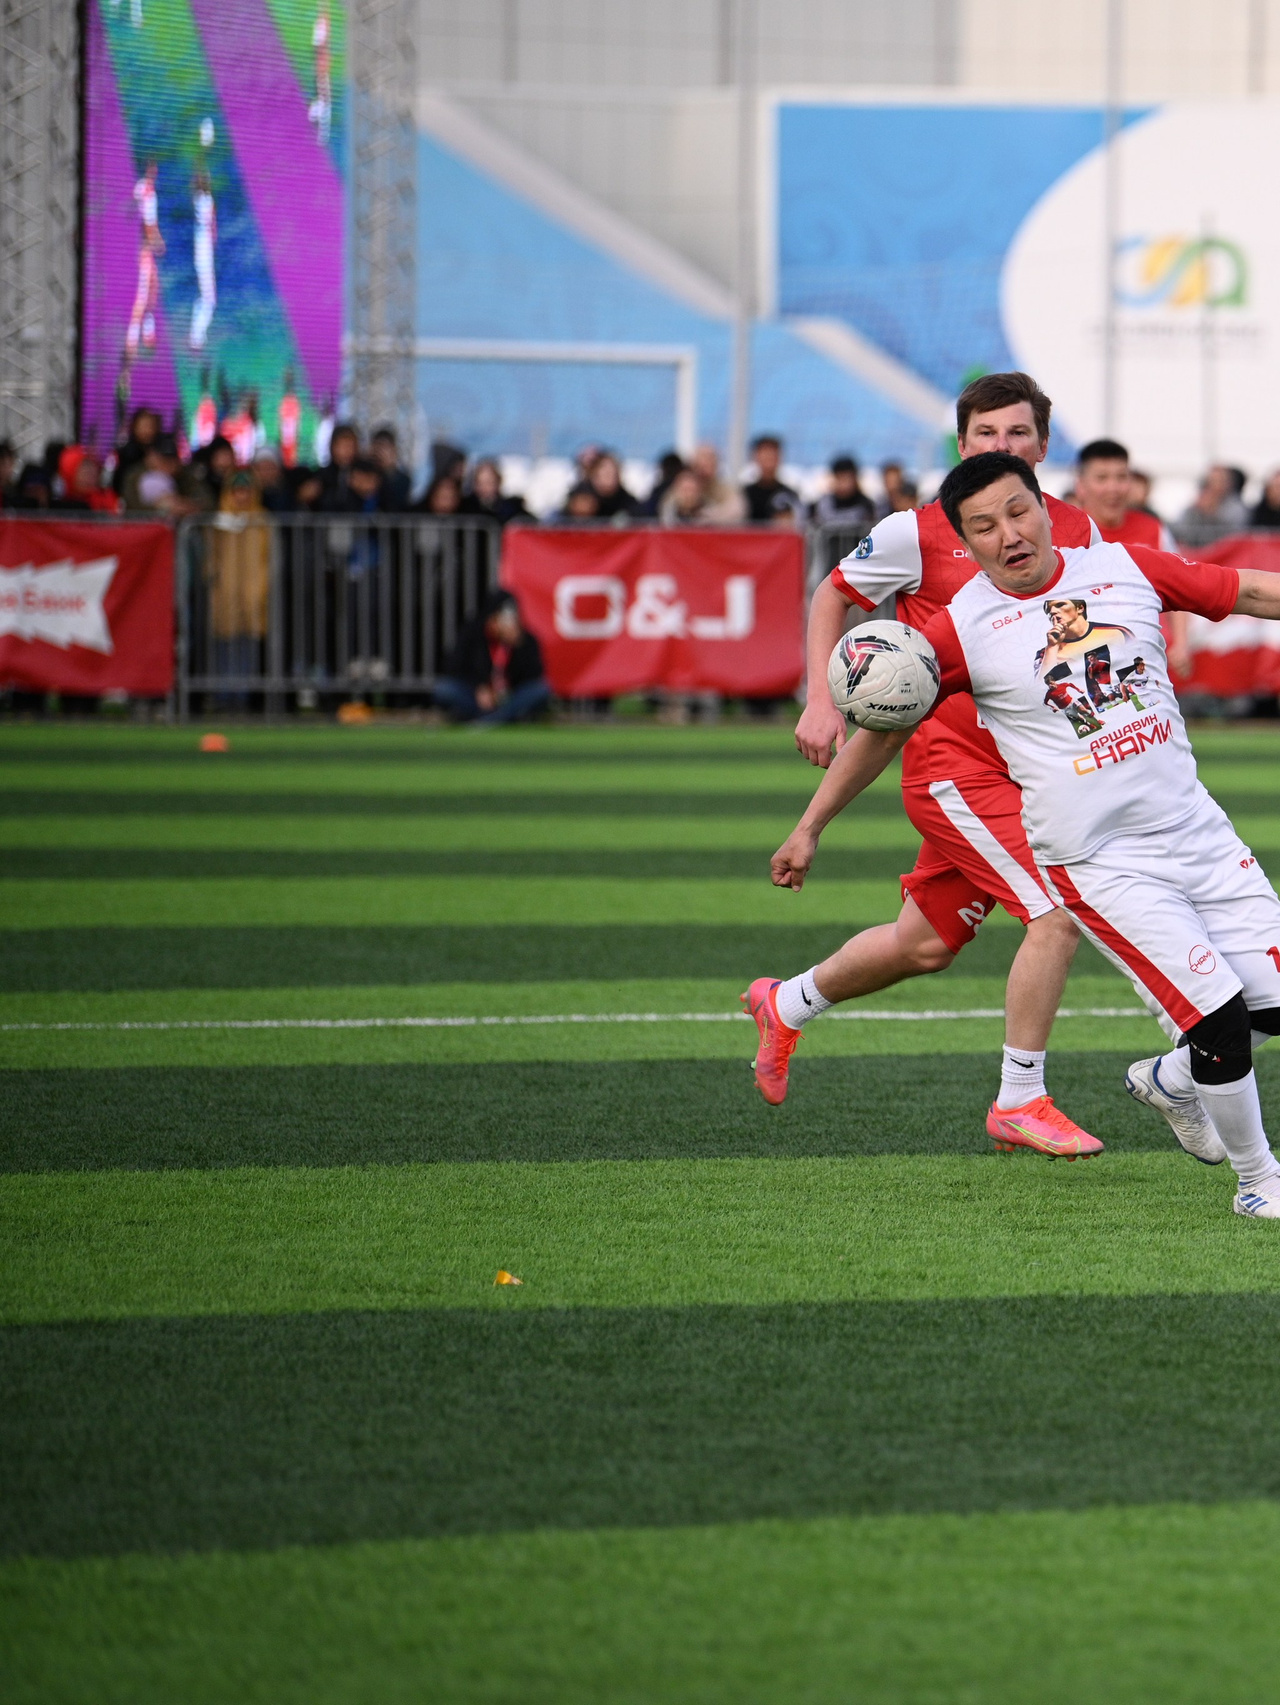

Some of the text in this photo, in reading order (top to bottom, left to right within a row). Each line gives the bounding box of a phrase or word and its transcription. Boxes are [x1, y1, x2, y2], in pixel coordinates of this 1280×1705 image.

[554, 573, 756, 640] O&J
[991, 610, 1023, 630] O&J
[866, 702, 918, 712] DEMIX
[1090, 713, 1159, 752] АРШАВИН
[957, 900, 987, 935] 2
